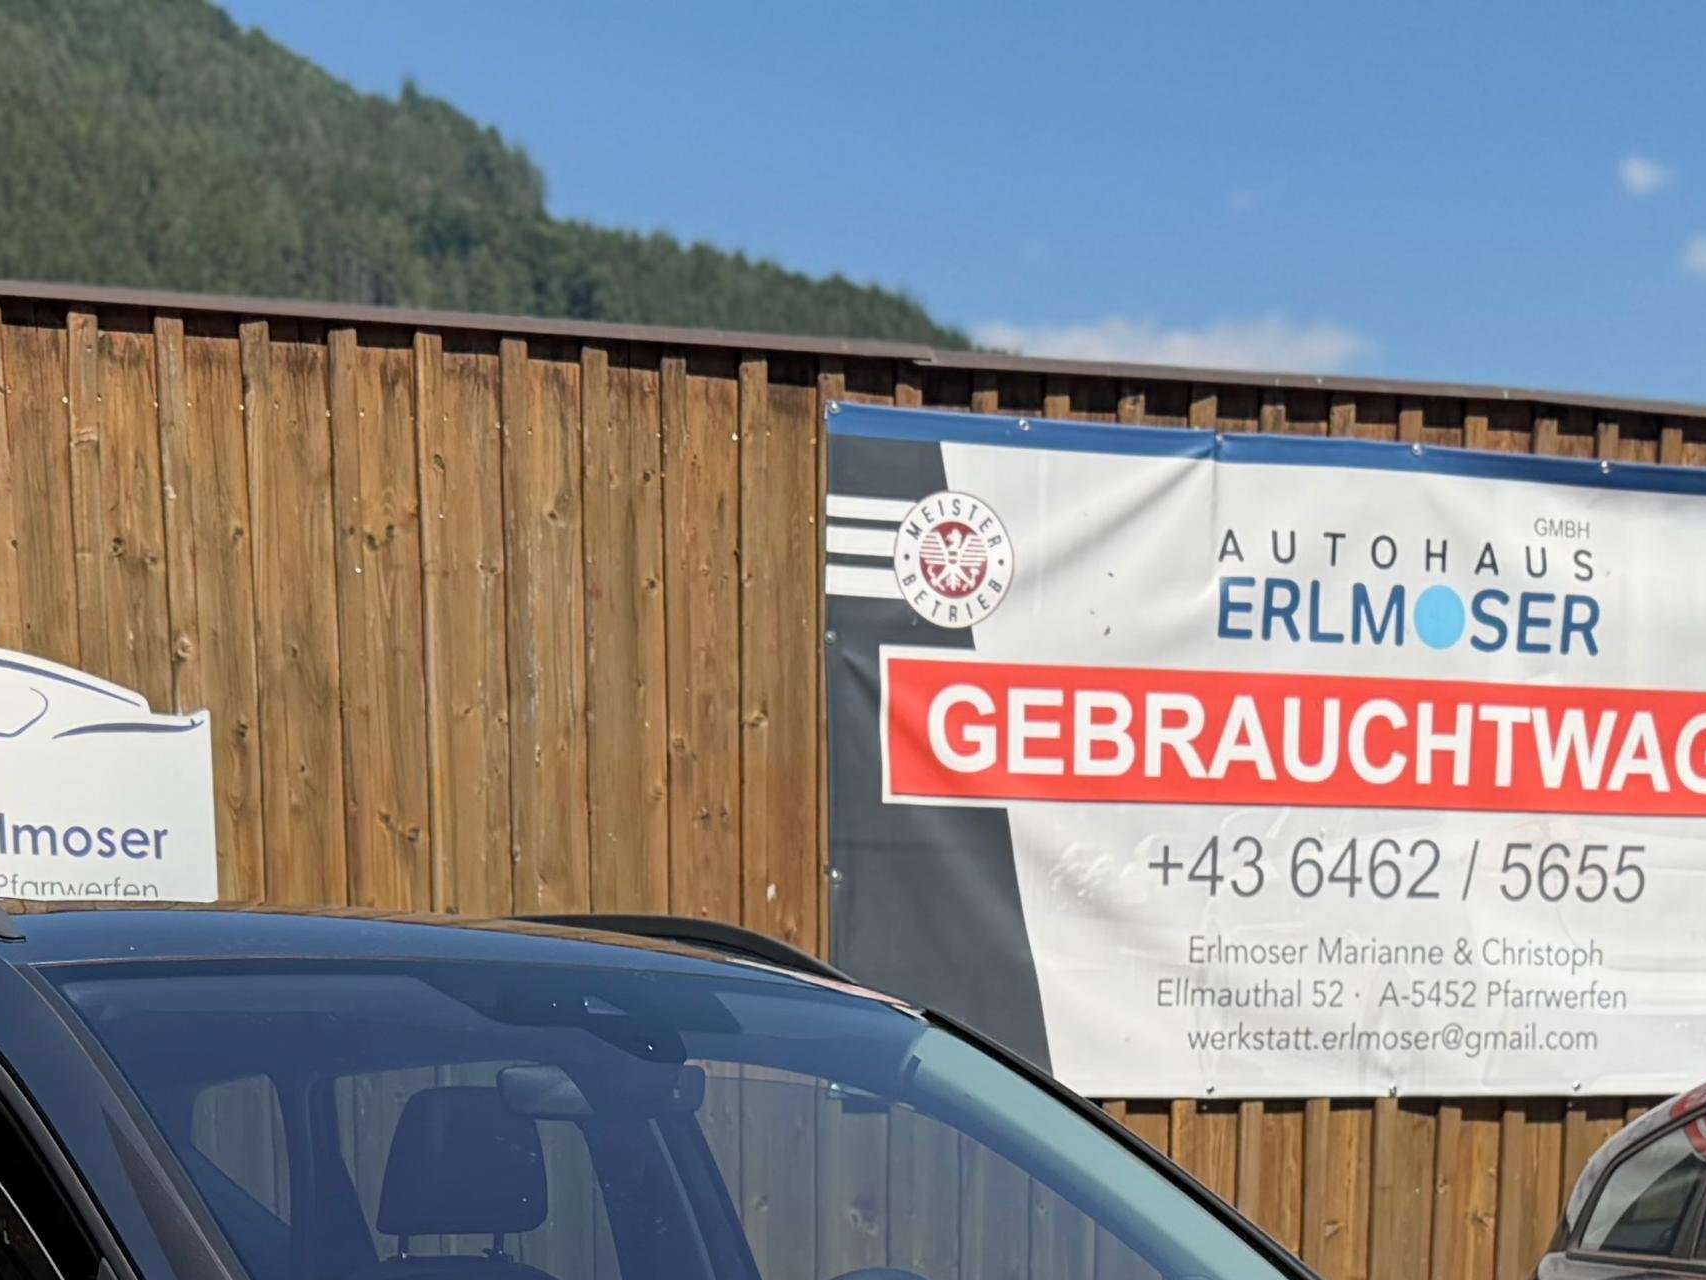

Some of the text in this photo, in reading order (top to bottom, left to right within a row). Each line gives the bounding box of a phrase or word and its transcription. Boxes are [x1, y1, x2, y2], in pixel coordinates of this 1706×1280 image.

[905, 498, 1002, 549] MEISTER
[1534, 518, 1591, 540] GMBH
[1218, 528, 1594, 582] AUTOHAUS
[902, 573, 1003, 623] BETRIEB
[1217, 576, 1601, 657] ERLMOSER
[1148, 835, 1265, 899] +43
[1290, 836, 1441, 901] 6462
[1499, 842, 1647, 904] 5655
[1188, 934, 1604, 976] Erlmoser Marianne & Christoph
[1156, 978, 1628, 1011] Ellmauthal 52 A-5452 Pfarrwerfen
[1187, 1022, 1599, 1058] werkstatt.erlmoser@gmail.com
